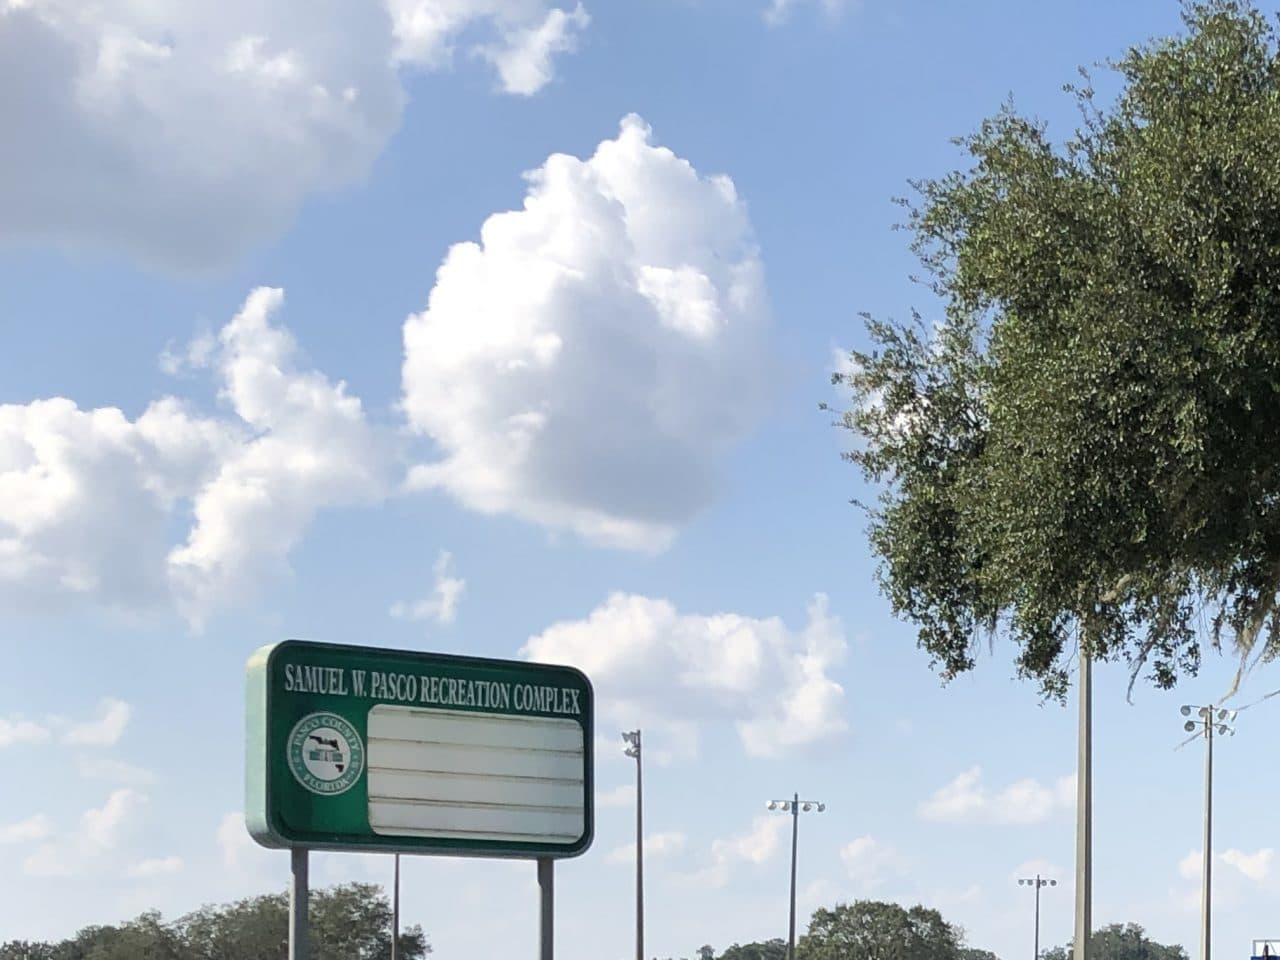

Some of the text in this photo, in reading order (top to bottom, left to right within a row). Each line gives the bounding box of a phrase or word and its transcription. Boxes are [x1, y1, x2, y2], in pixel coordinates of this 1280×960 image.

[284, 664, 581, 714] SAMUEL W. PASCO RECREATION COMPLEX
